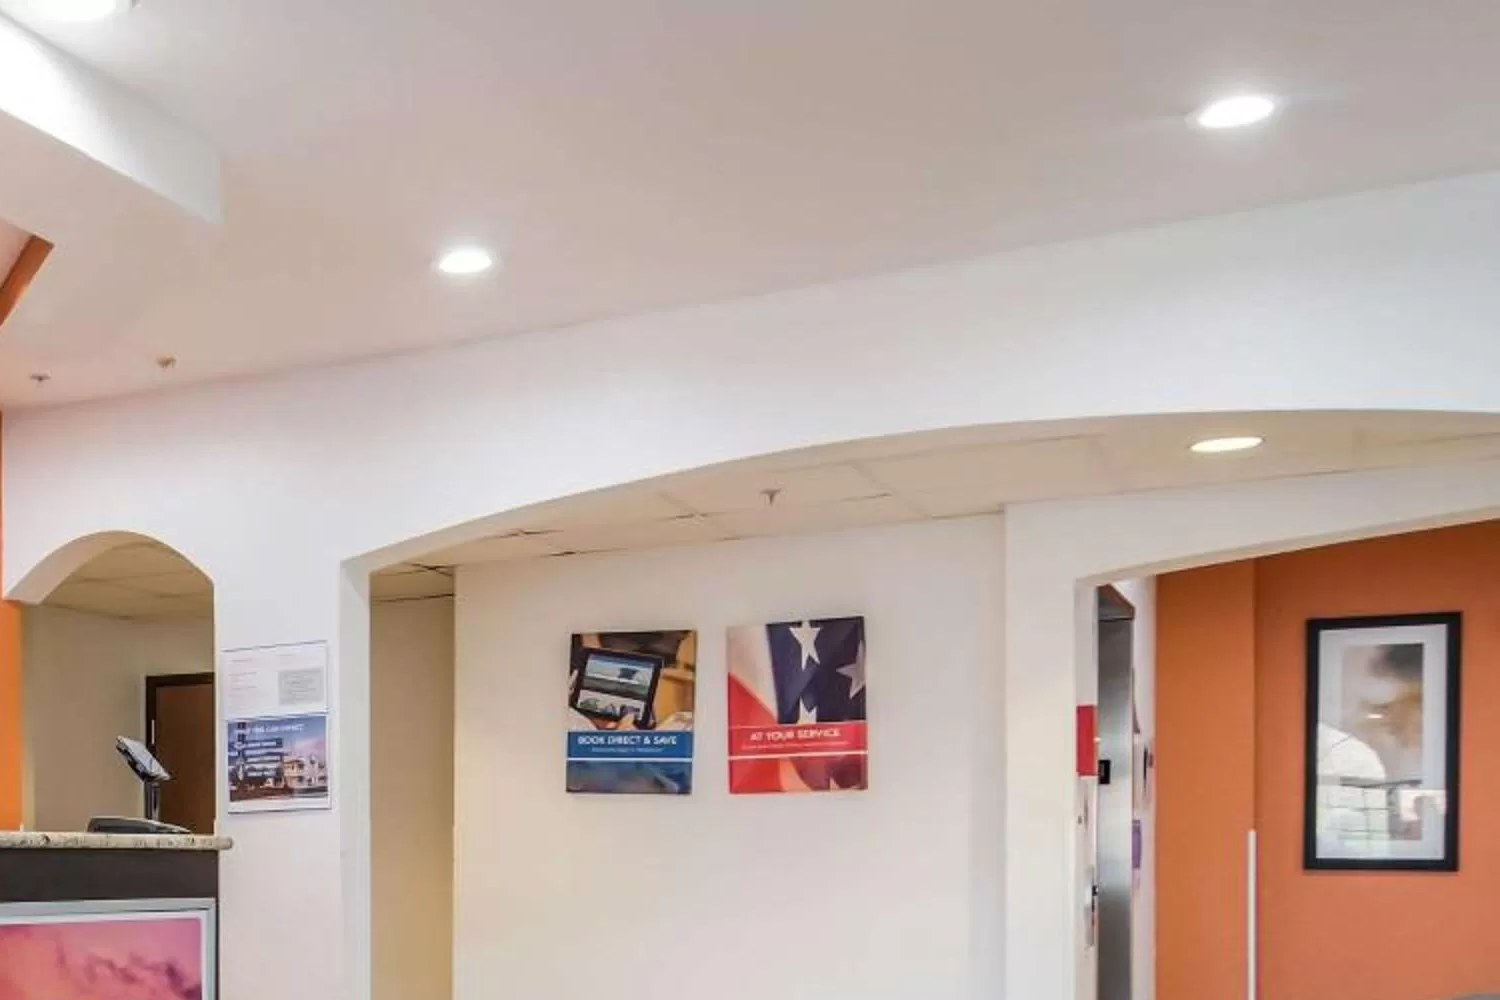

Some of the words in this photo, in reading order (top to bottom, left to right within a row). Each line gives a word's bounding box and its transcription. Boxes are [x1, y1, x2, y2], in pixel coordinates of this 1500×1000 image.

[577, 735, 605, 745] BOOK
[607, 735, 641, 745] DIRECT
[643, 735, 651, 745] &
[653, 735, 677, 745] SAVE
[750, 731, 763, 741] AT
[766, 731, 794, 741] YOUR
[797, 728, 841, 739] SERVICE
